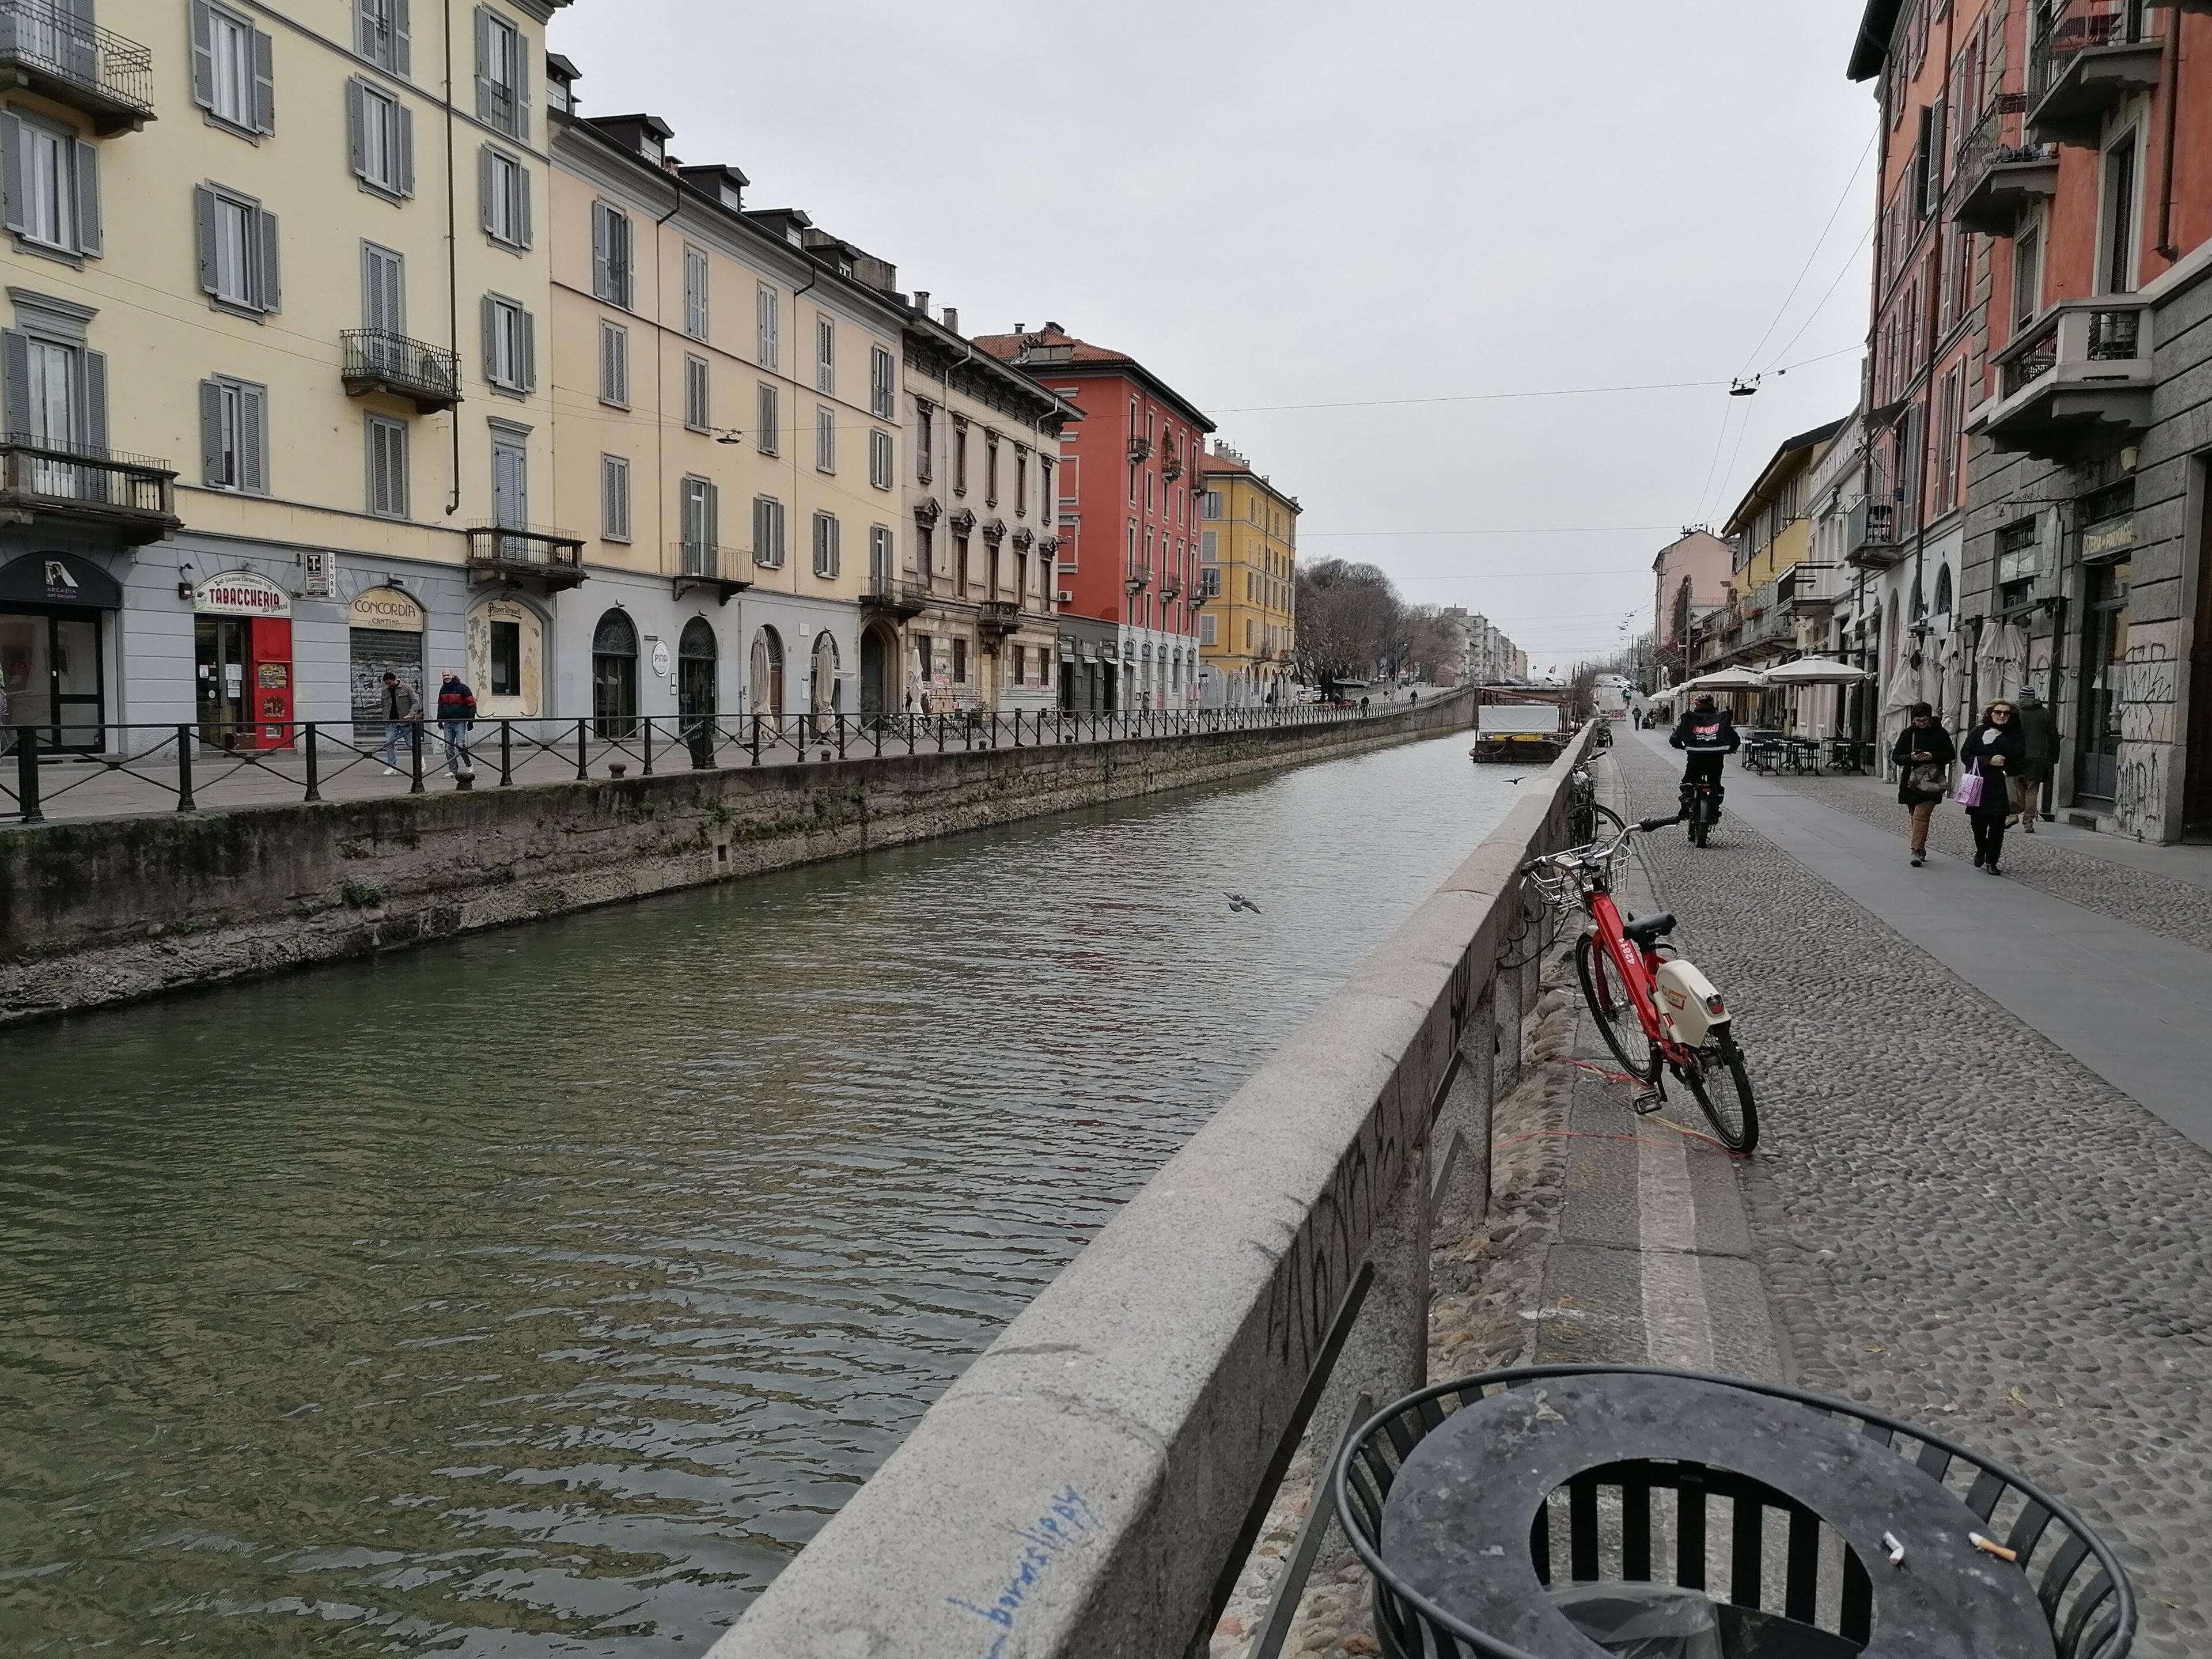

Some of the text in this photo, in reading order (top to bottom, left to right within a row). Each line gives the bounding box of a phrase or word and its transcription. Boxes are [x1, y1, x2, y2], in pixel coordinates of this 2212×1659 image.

[2082, 533, 2101, 556] OSTERIA
[209, 587, 279, 608] TABACCHERIA
[354, 600, 416, 618] CONCORDIA
[372, 618, 400, 626] CANTINA
[1618, 938, 1635, 964] 42811
